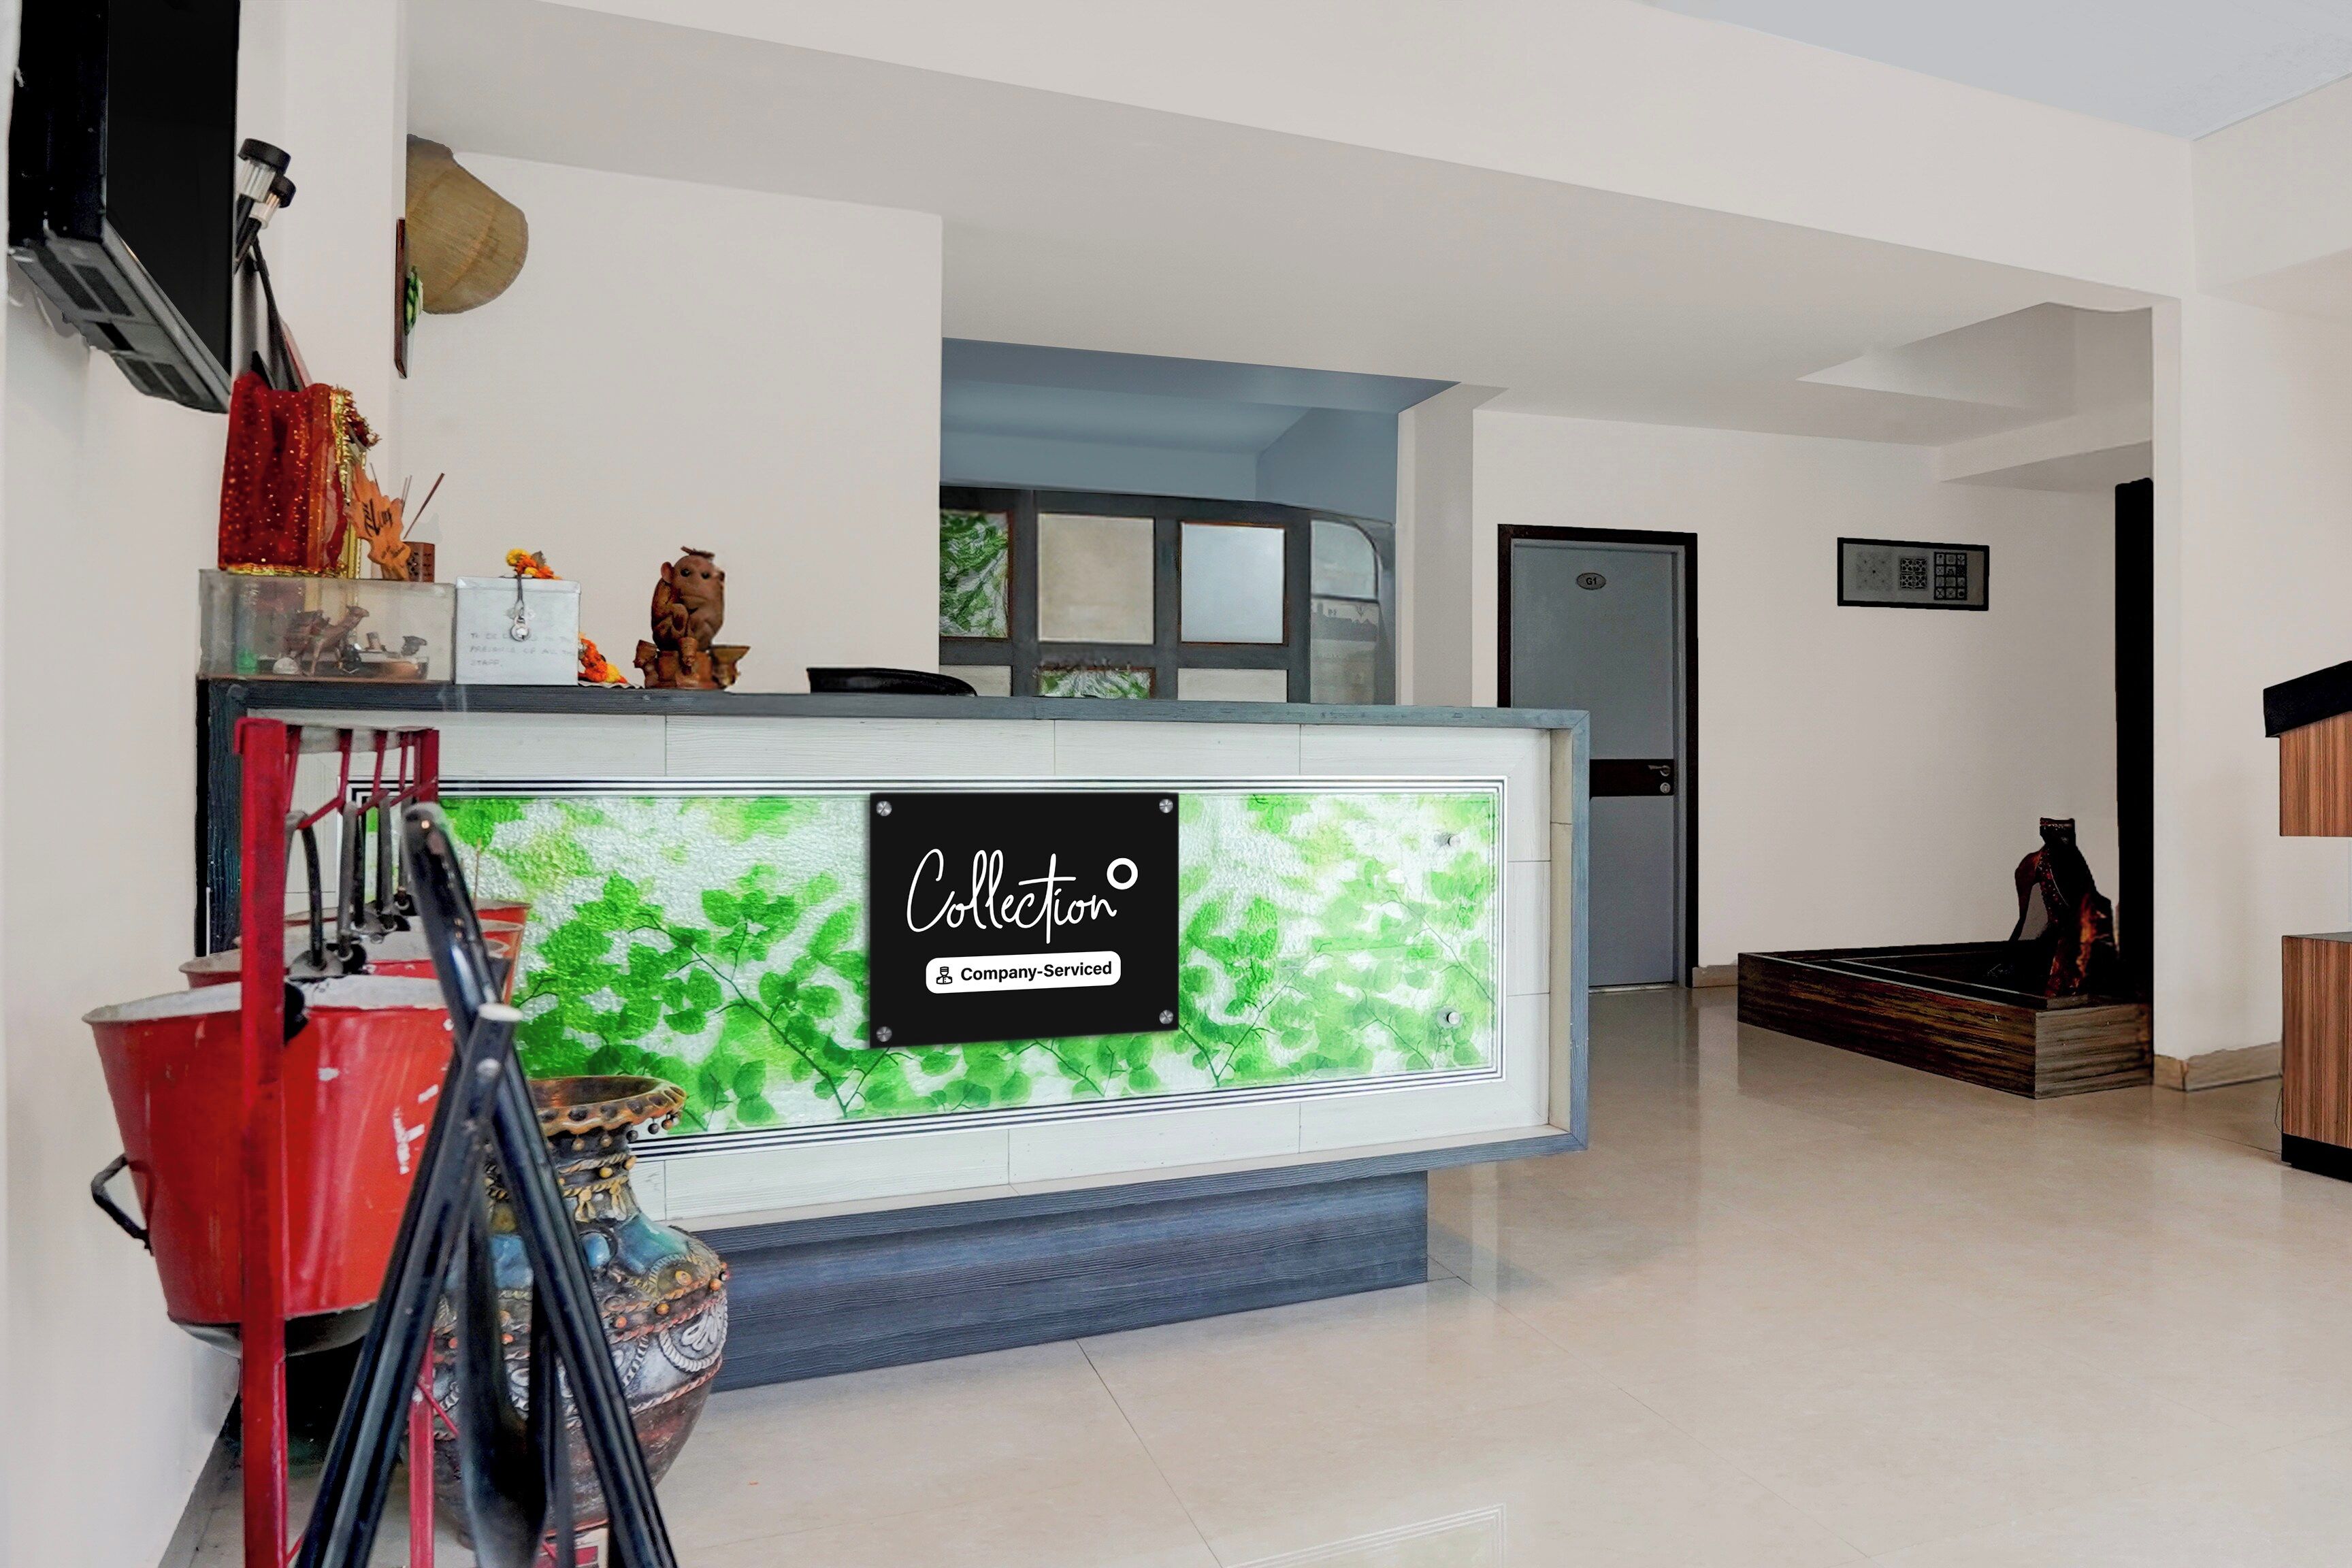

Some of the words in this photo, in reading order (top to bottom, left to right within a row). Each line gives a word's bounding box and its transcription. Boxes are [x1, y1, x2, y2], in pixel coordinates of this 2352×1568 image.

[1586, 576, 1597, 585] G1
[906, 848, 1117, 945] Collection
[960, 960, 1112, 983] Company-Serviced
